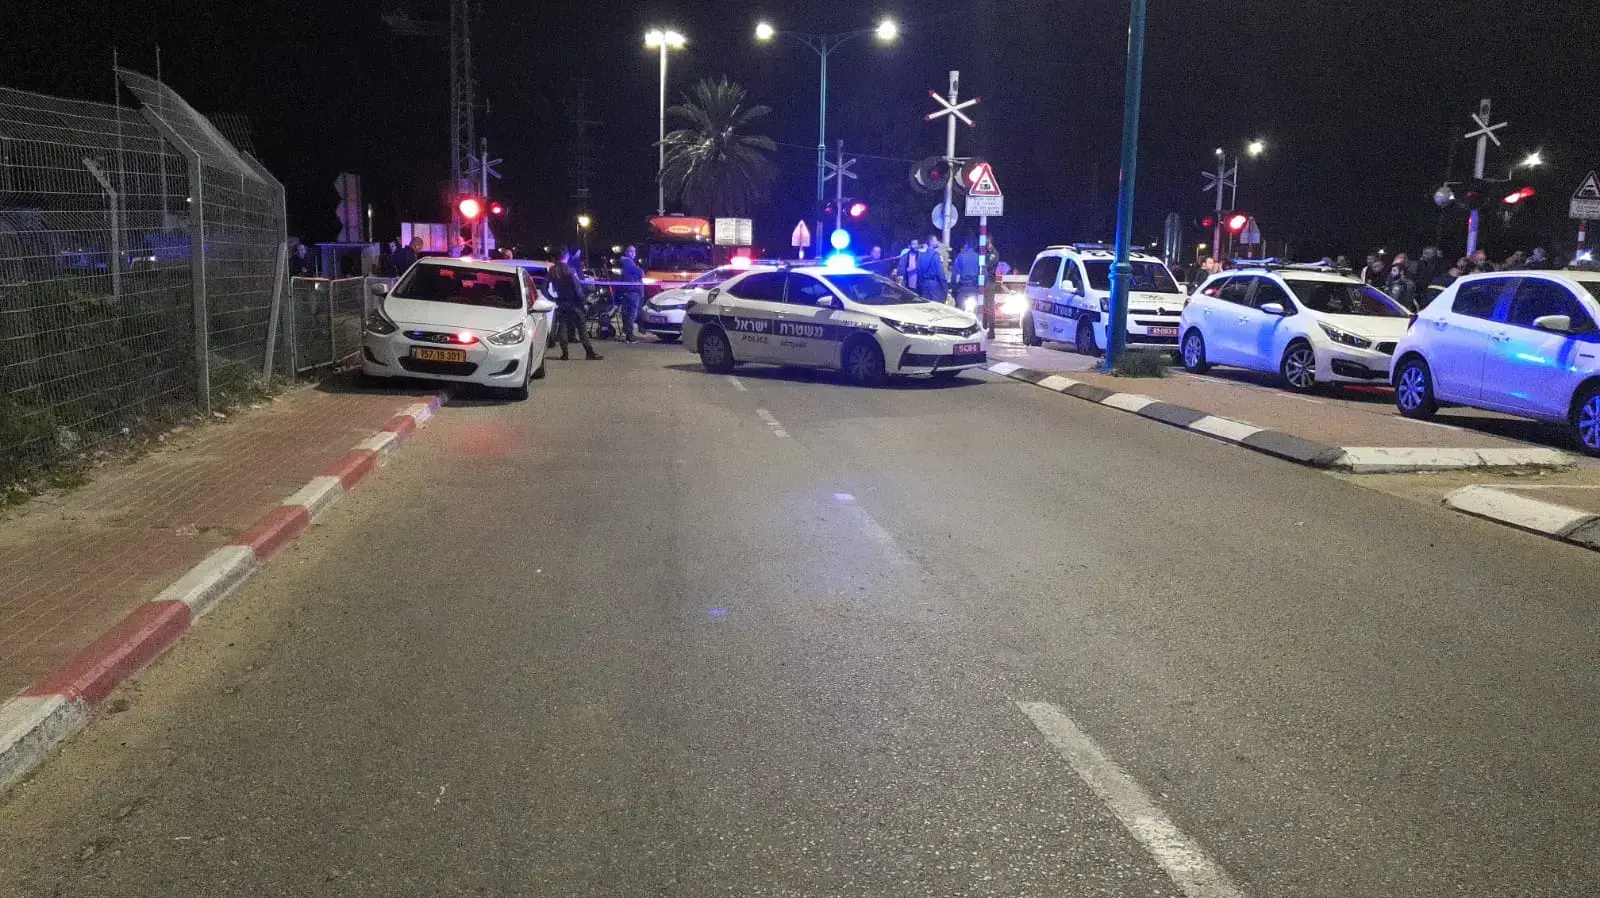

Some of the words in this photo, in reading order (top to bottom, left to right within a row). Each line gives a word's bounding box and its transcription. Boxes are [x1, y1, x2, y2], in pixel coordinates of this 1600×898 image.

[734, 317, 768, 332] ישראל
[780, 323, 823, 338] משטרת
[742, 334, 769, 344] POLICE
